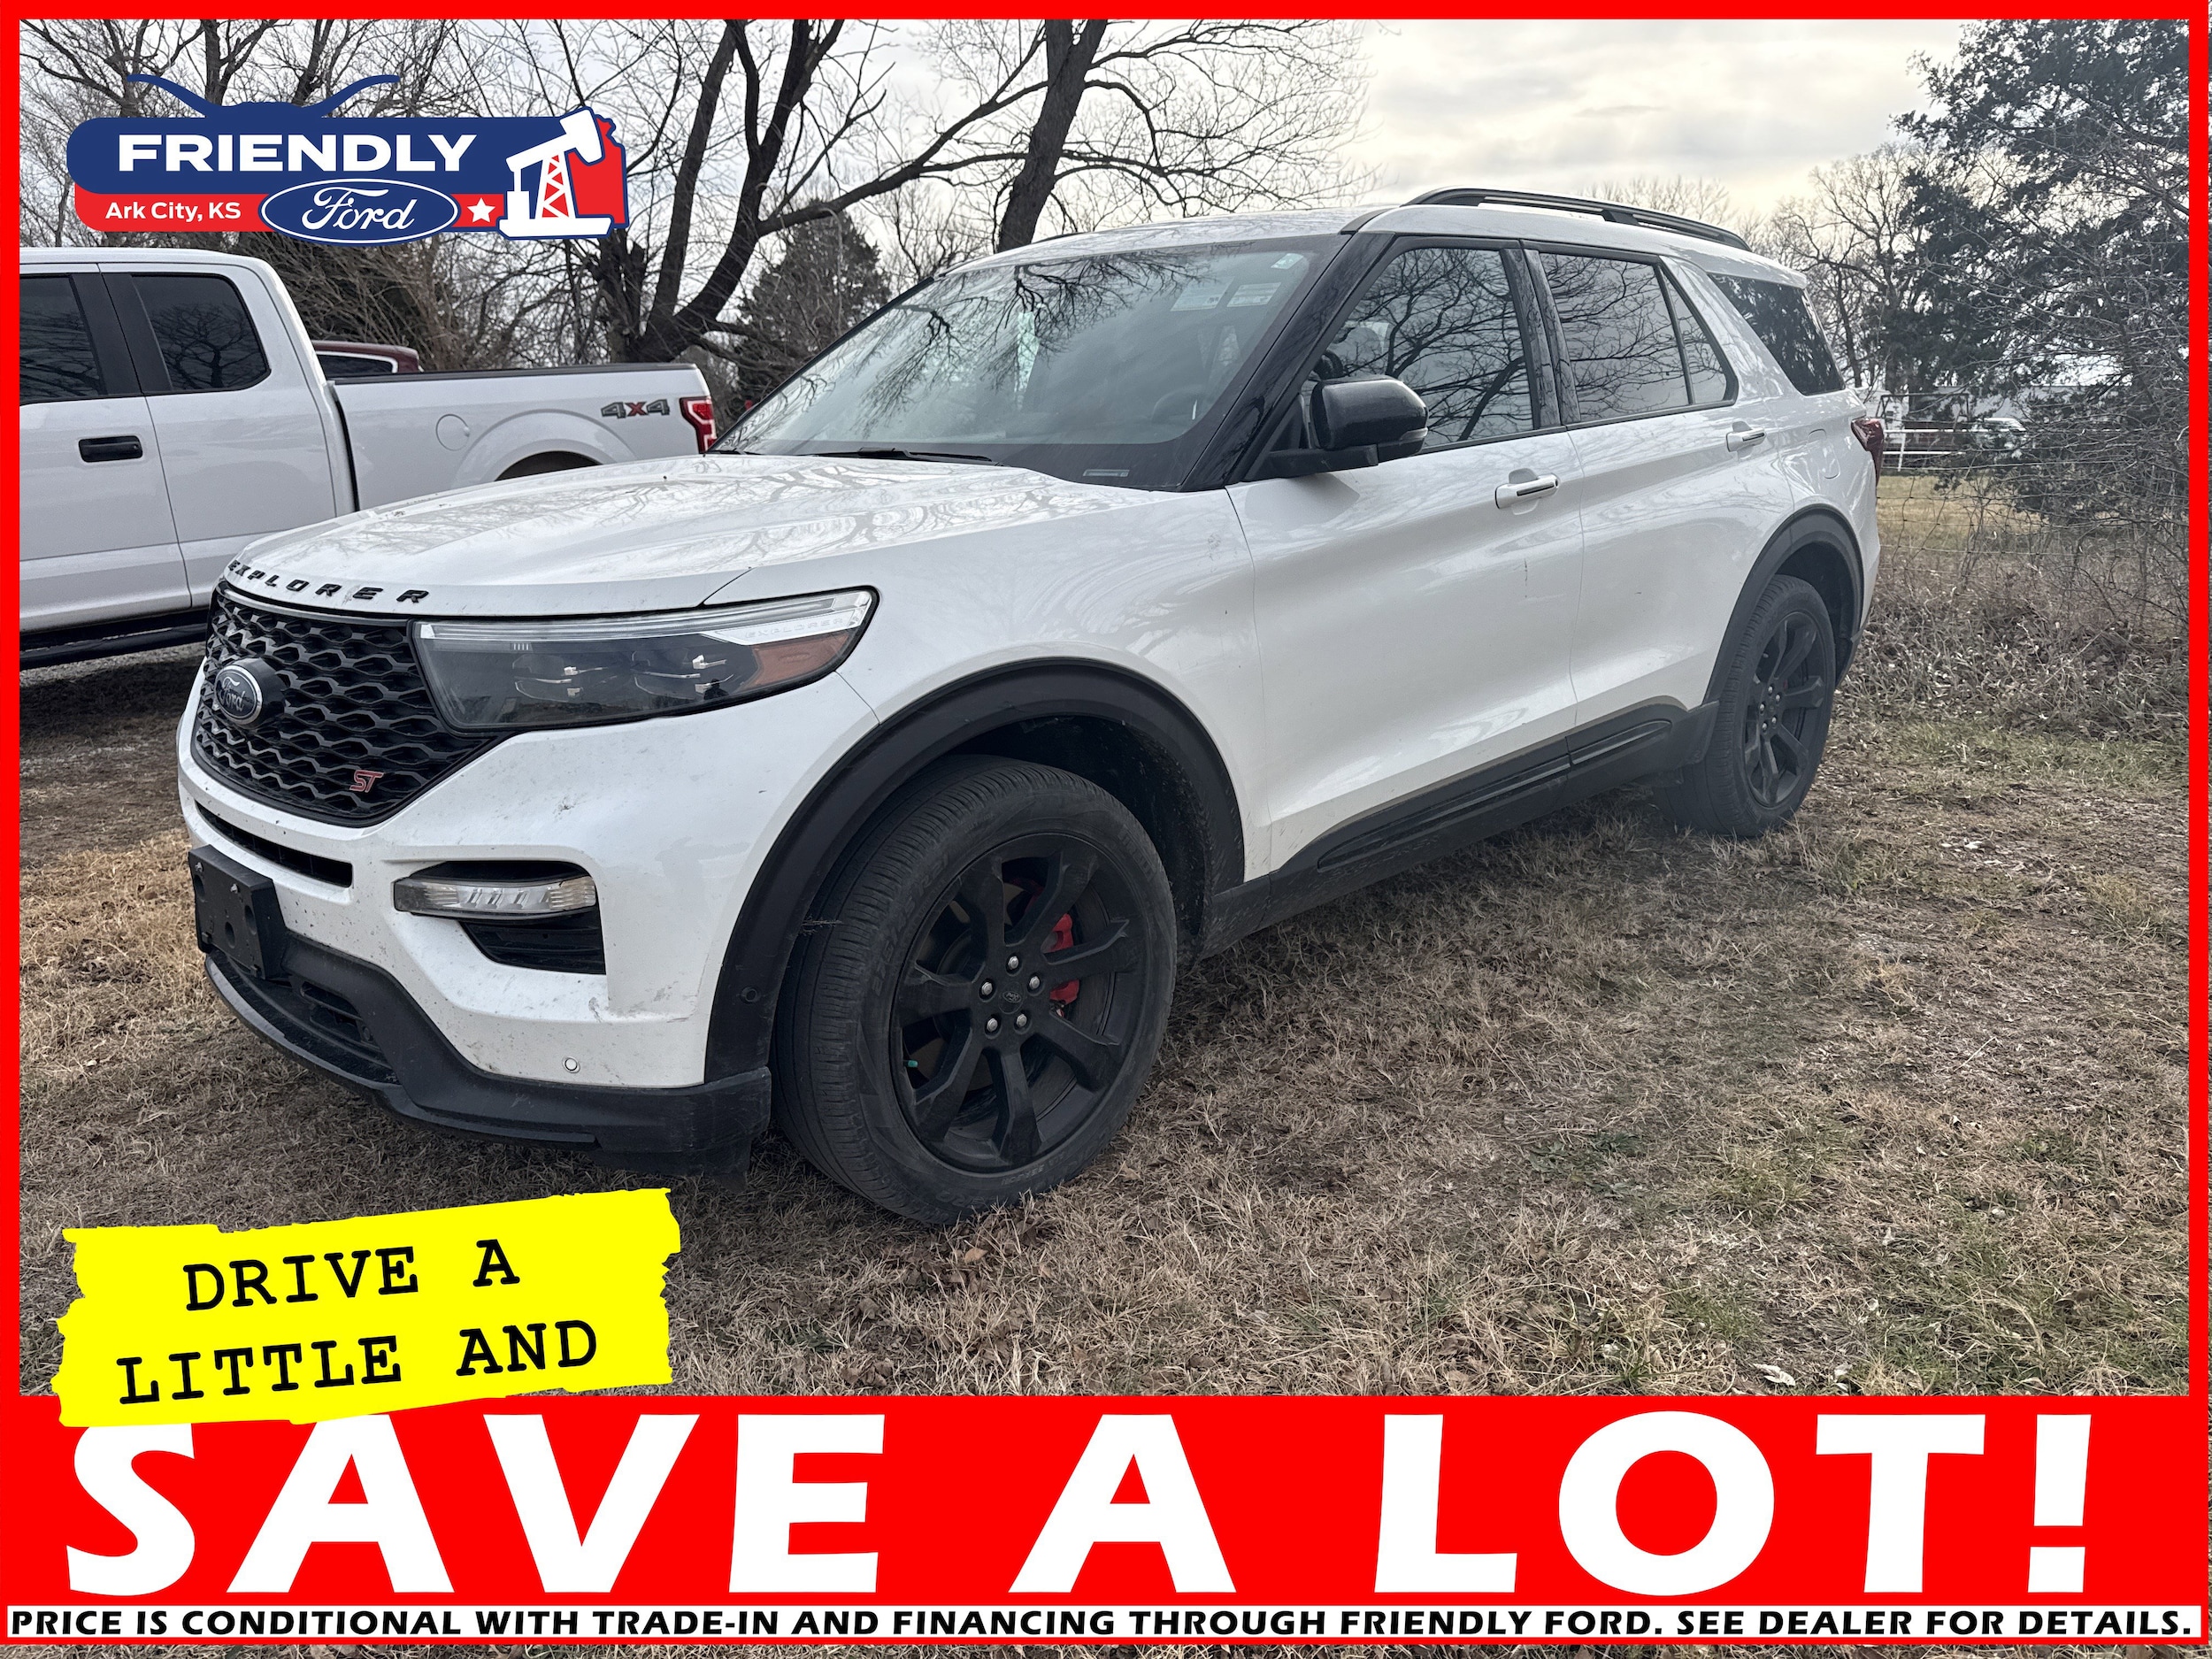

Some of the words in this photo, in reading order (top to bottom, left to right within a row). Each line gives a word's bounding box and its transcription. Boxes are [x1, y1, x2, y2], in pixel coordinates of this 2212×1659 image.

[227, 559, 430, 603] EXPLORER
[745, 618, 843, 639] EXPLORER
[220, 676, 247, 712] Ford
[349, 770, 385, 793] ST
